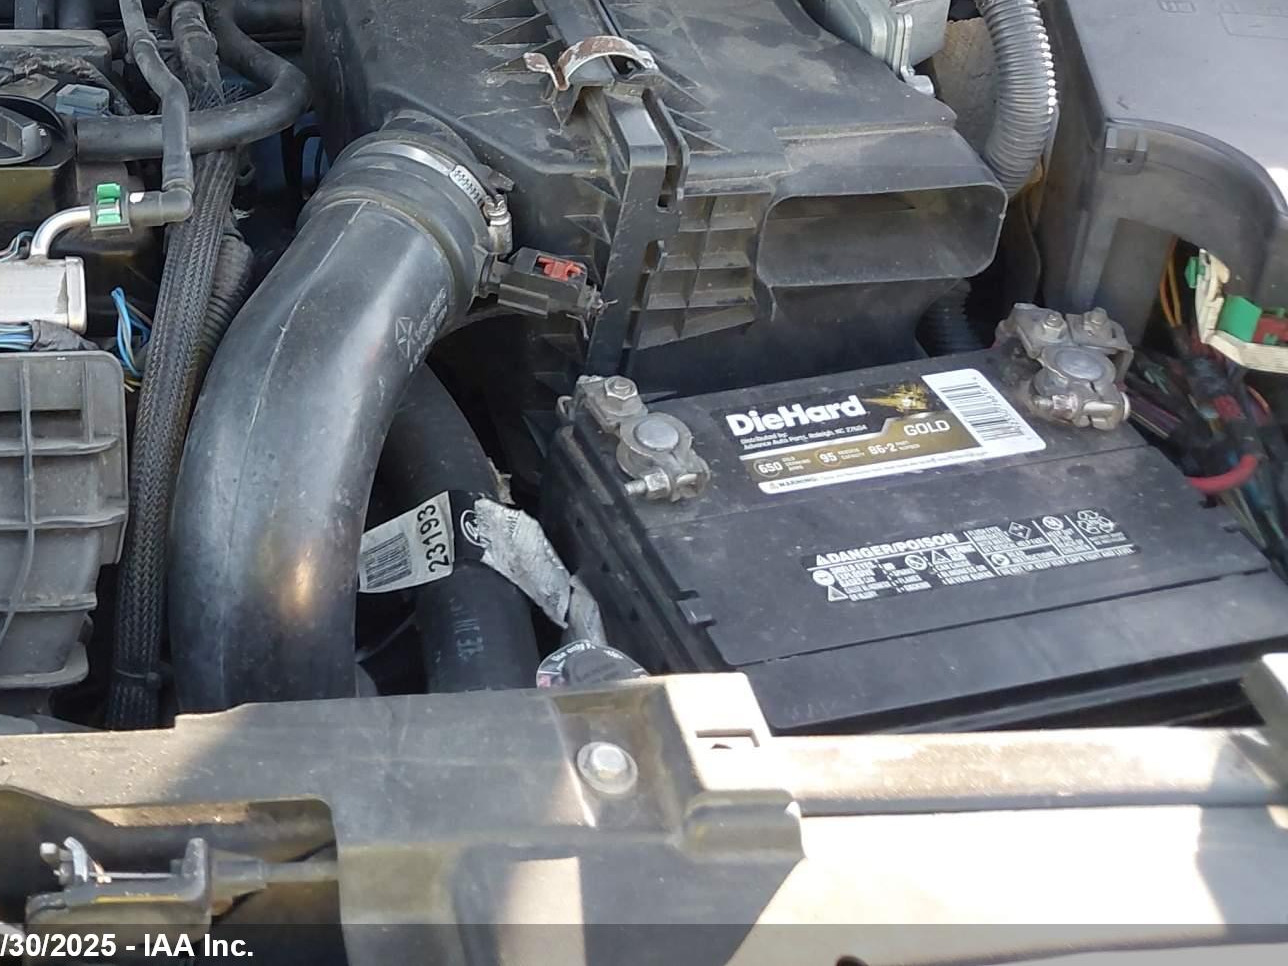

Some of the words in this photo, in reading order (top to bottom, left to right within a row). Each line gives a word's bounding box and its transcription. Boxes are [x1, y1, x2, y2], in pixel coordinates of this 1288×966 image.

[725, 394, 867, 437] DieHard
[903, 419, 951, 436] GOLD
[758, 461, 784, 474] 650
[819, 452, 839, 463] 95
[417, 504, 450, 573] 23193
[826, 532, 959, 564] DANGER/POISON
